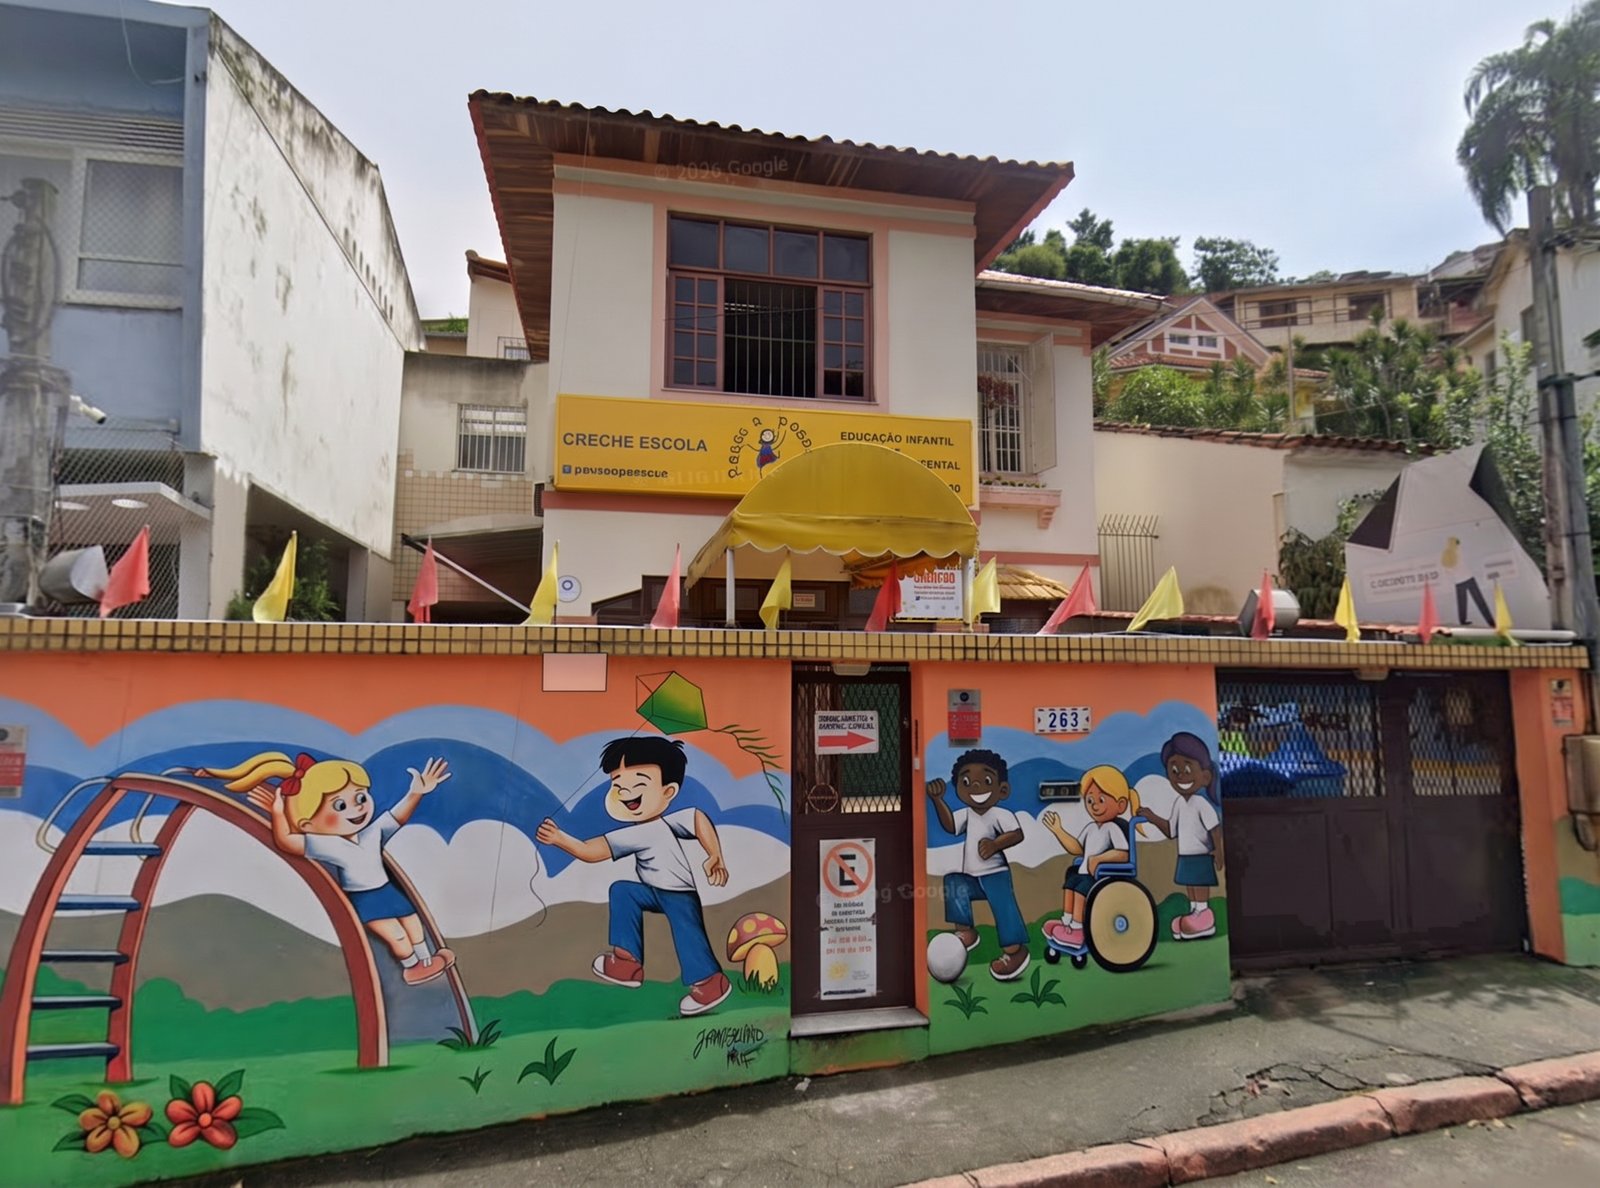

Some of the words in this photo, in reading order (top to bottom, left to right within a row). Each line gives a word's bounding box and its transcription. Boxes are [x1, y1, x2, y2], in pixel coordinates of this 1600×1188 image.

[563, 432, 634, 449] CRECHE
[639, 436, 708, 452] ESCOLA
[840, 431, 902, 444] EDUCAÇÃO
[906, 435, 954, 446] INFANTIL
[1048, 711, 1079, 728] 263
